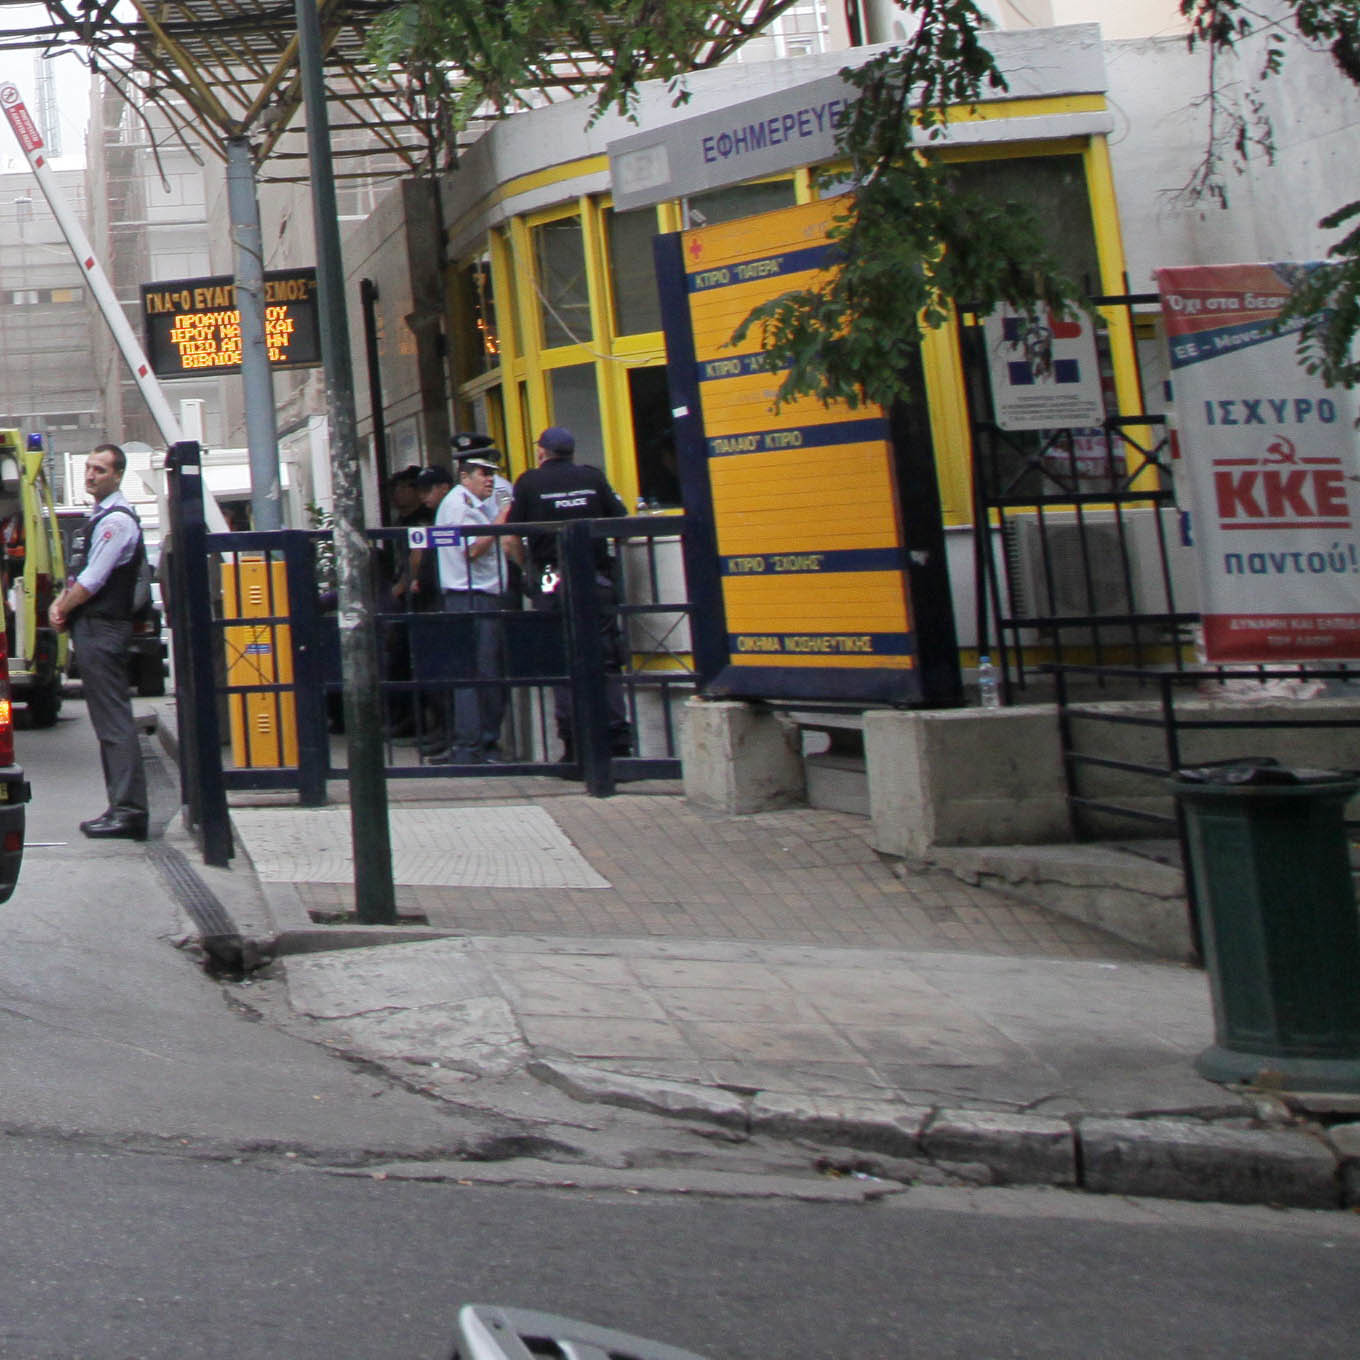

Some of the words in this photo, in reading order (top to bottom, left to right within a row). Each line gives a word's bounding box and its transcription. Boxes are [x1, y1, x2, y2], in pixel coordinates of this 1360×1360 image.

[1205, 398, 1337, 425] ΙΣΧΥΡΟ
[555, 497, 588, 509] POLICE
[1214, 470, 1350, 518] ΚΚΕ
[1224, 542, 1359, 574] παντού!
